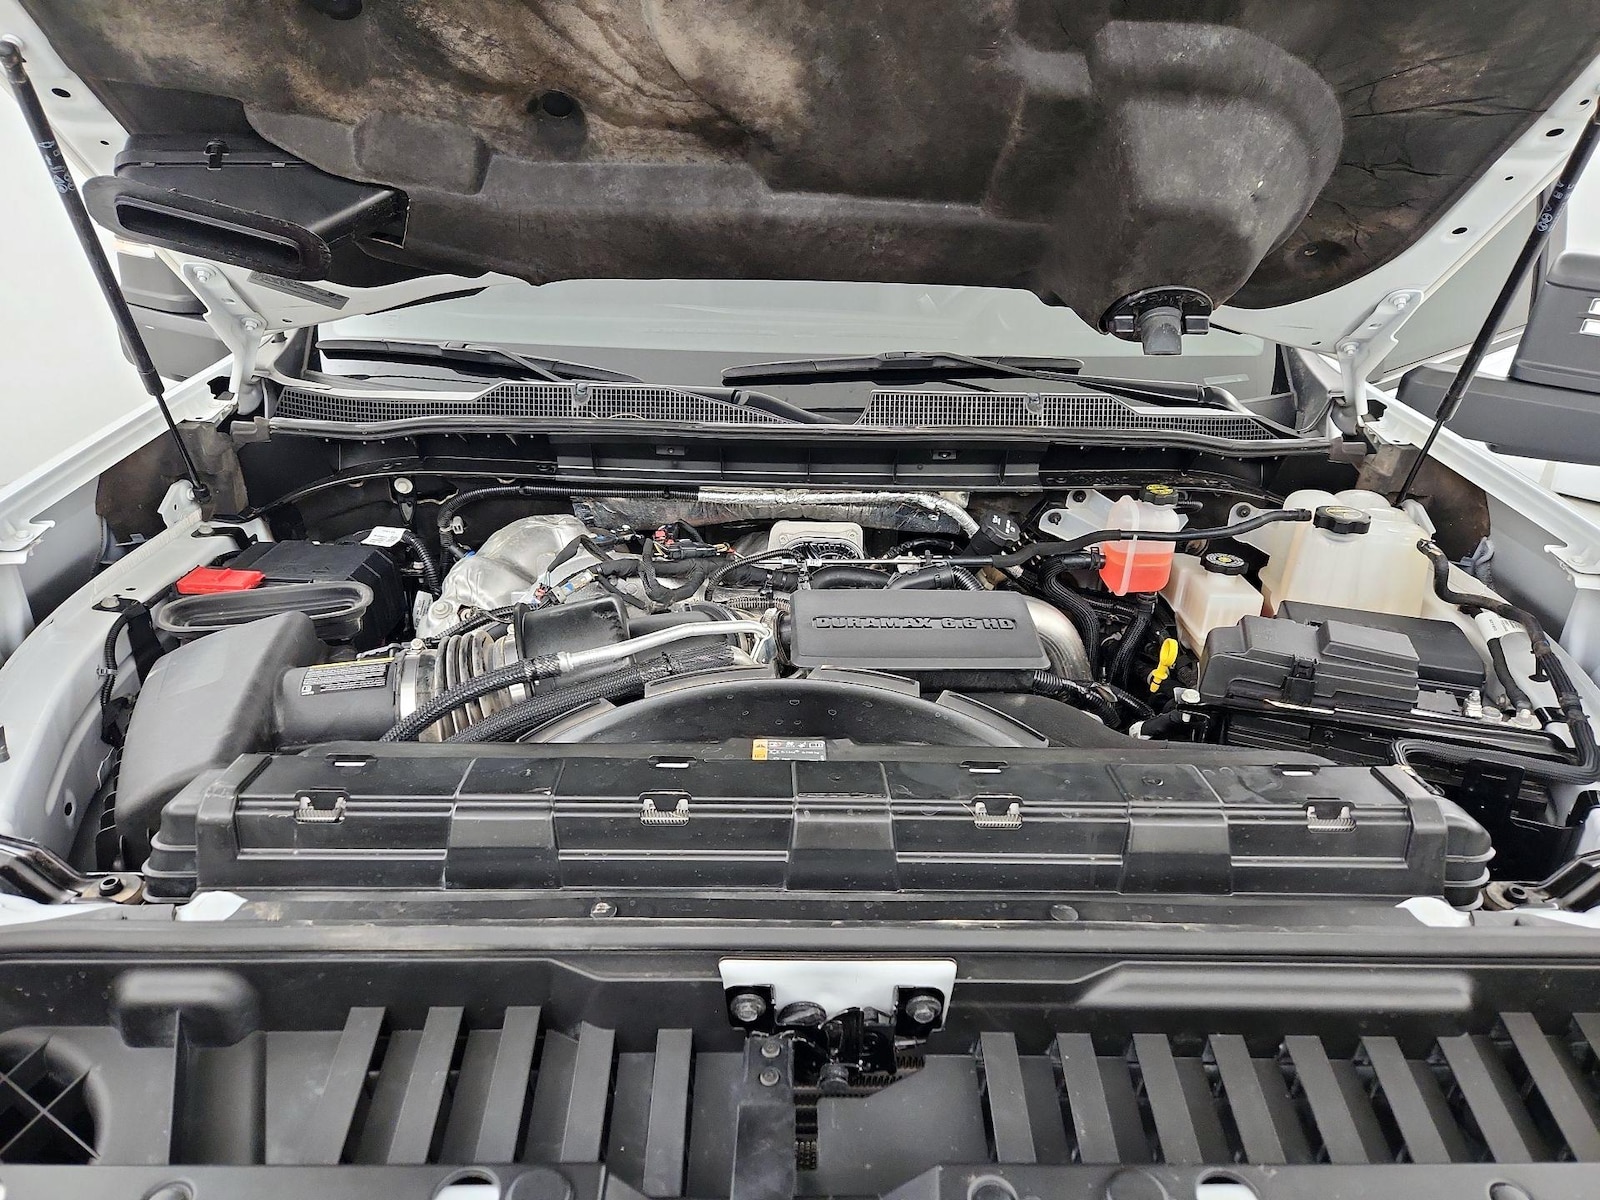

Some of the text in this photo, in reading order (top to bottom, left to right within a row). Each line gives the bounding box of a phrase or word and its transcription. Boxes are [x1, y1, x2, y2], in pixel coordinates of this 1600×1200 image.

[815, 617, 1016, 630] DURAMAX 6.6 HD
